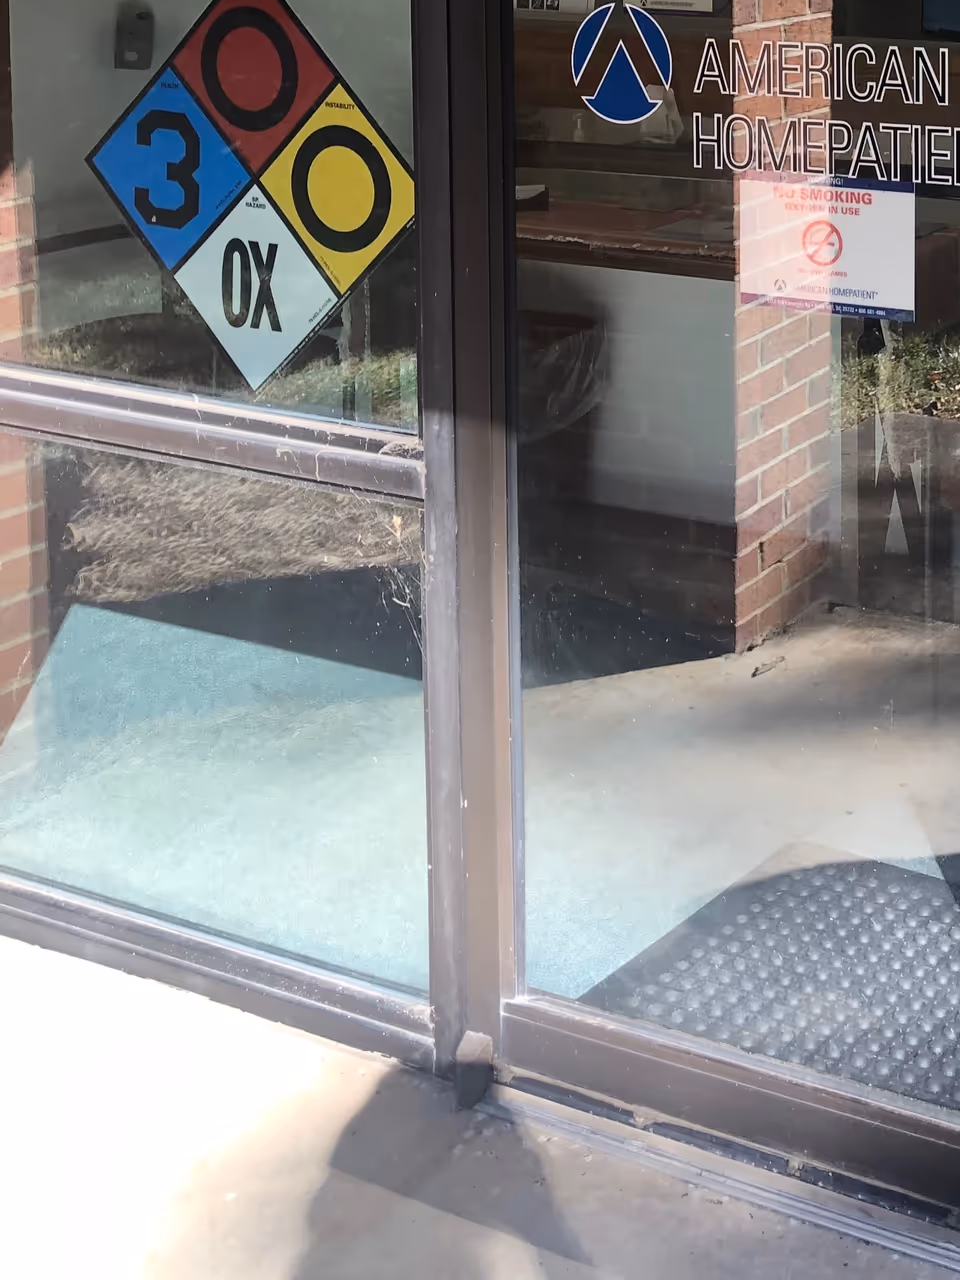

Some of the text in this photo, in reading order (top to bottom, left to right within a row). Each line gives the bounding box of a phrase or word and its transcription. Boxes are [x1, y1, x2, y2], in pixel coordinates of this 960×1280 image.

[694, 38, 949, 106] AMERICAN
[134, 110, 200, 229] 3
[800, 188, 873, 206] SMOKING
[828, 206, 838, 214] IN
[841, 207, 860, 216] USE
[222, 238, 282, 333] OX
